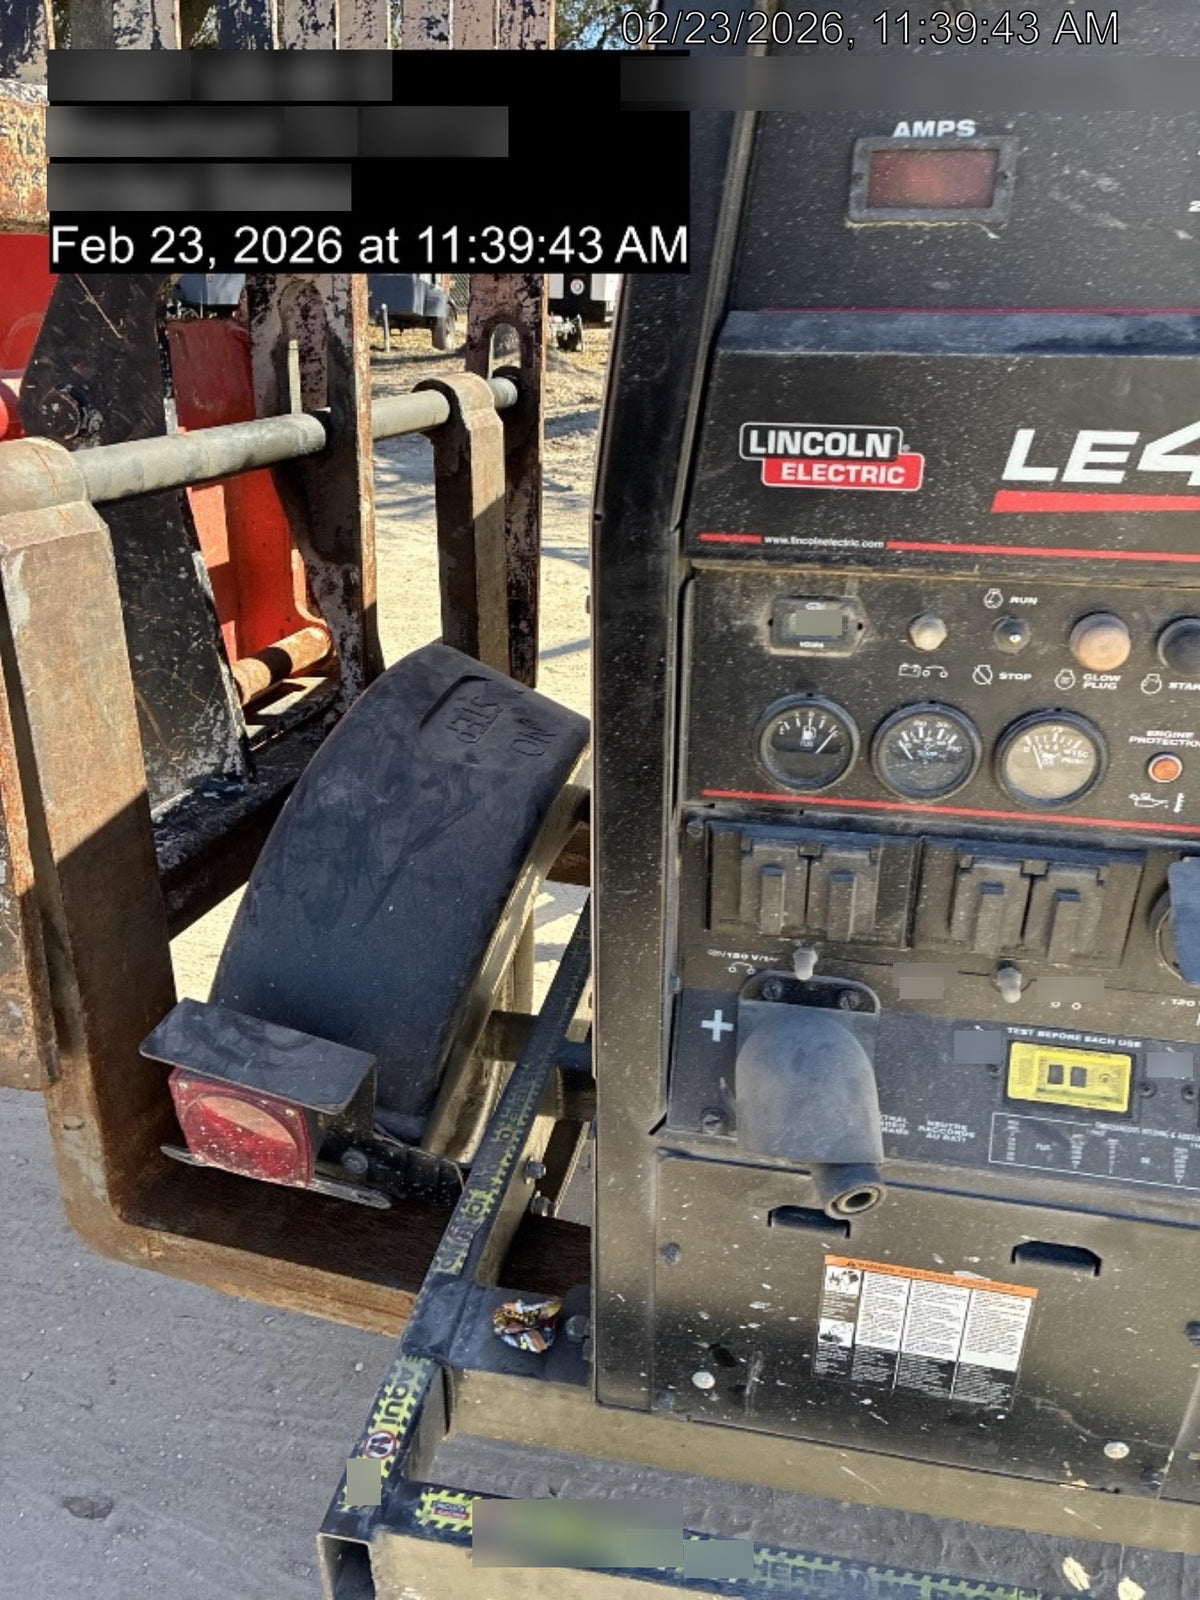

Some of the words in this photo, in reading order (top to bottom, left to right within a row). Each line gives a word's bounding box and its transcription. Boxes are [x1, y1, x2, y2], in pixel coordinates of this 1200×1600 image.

[892, 119, 977, 138] AMPS
[749, 429, 892, 458] LINCOLN
[780, 462, 906, 485] ELECTRIC
[1009, 596, 1038, 605] RUN
[998, 672, 1032, 681] STOP
[1082, 673, 1121, 682] GLOW
[1082, 680, 1118, 691] PLUG
[1146, 729, 1195, 739] ENGINE
[1006, 1026, 1035, 1037] TEST
[1037, 1030, 1082, 1042] BEFORE
[1084, 1035, 1116, 1046] EACH
[1118, 1039, 1143, 1049] USE
